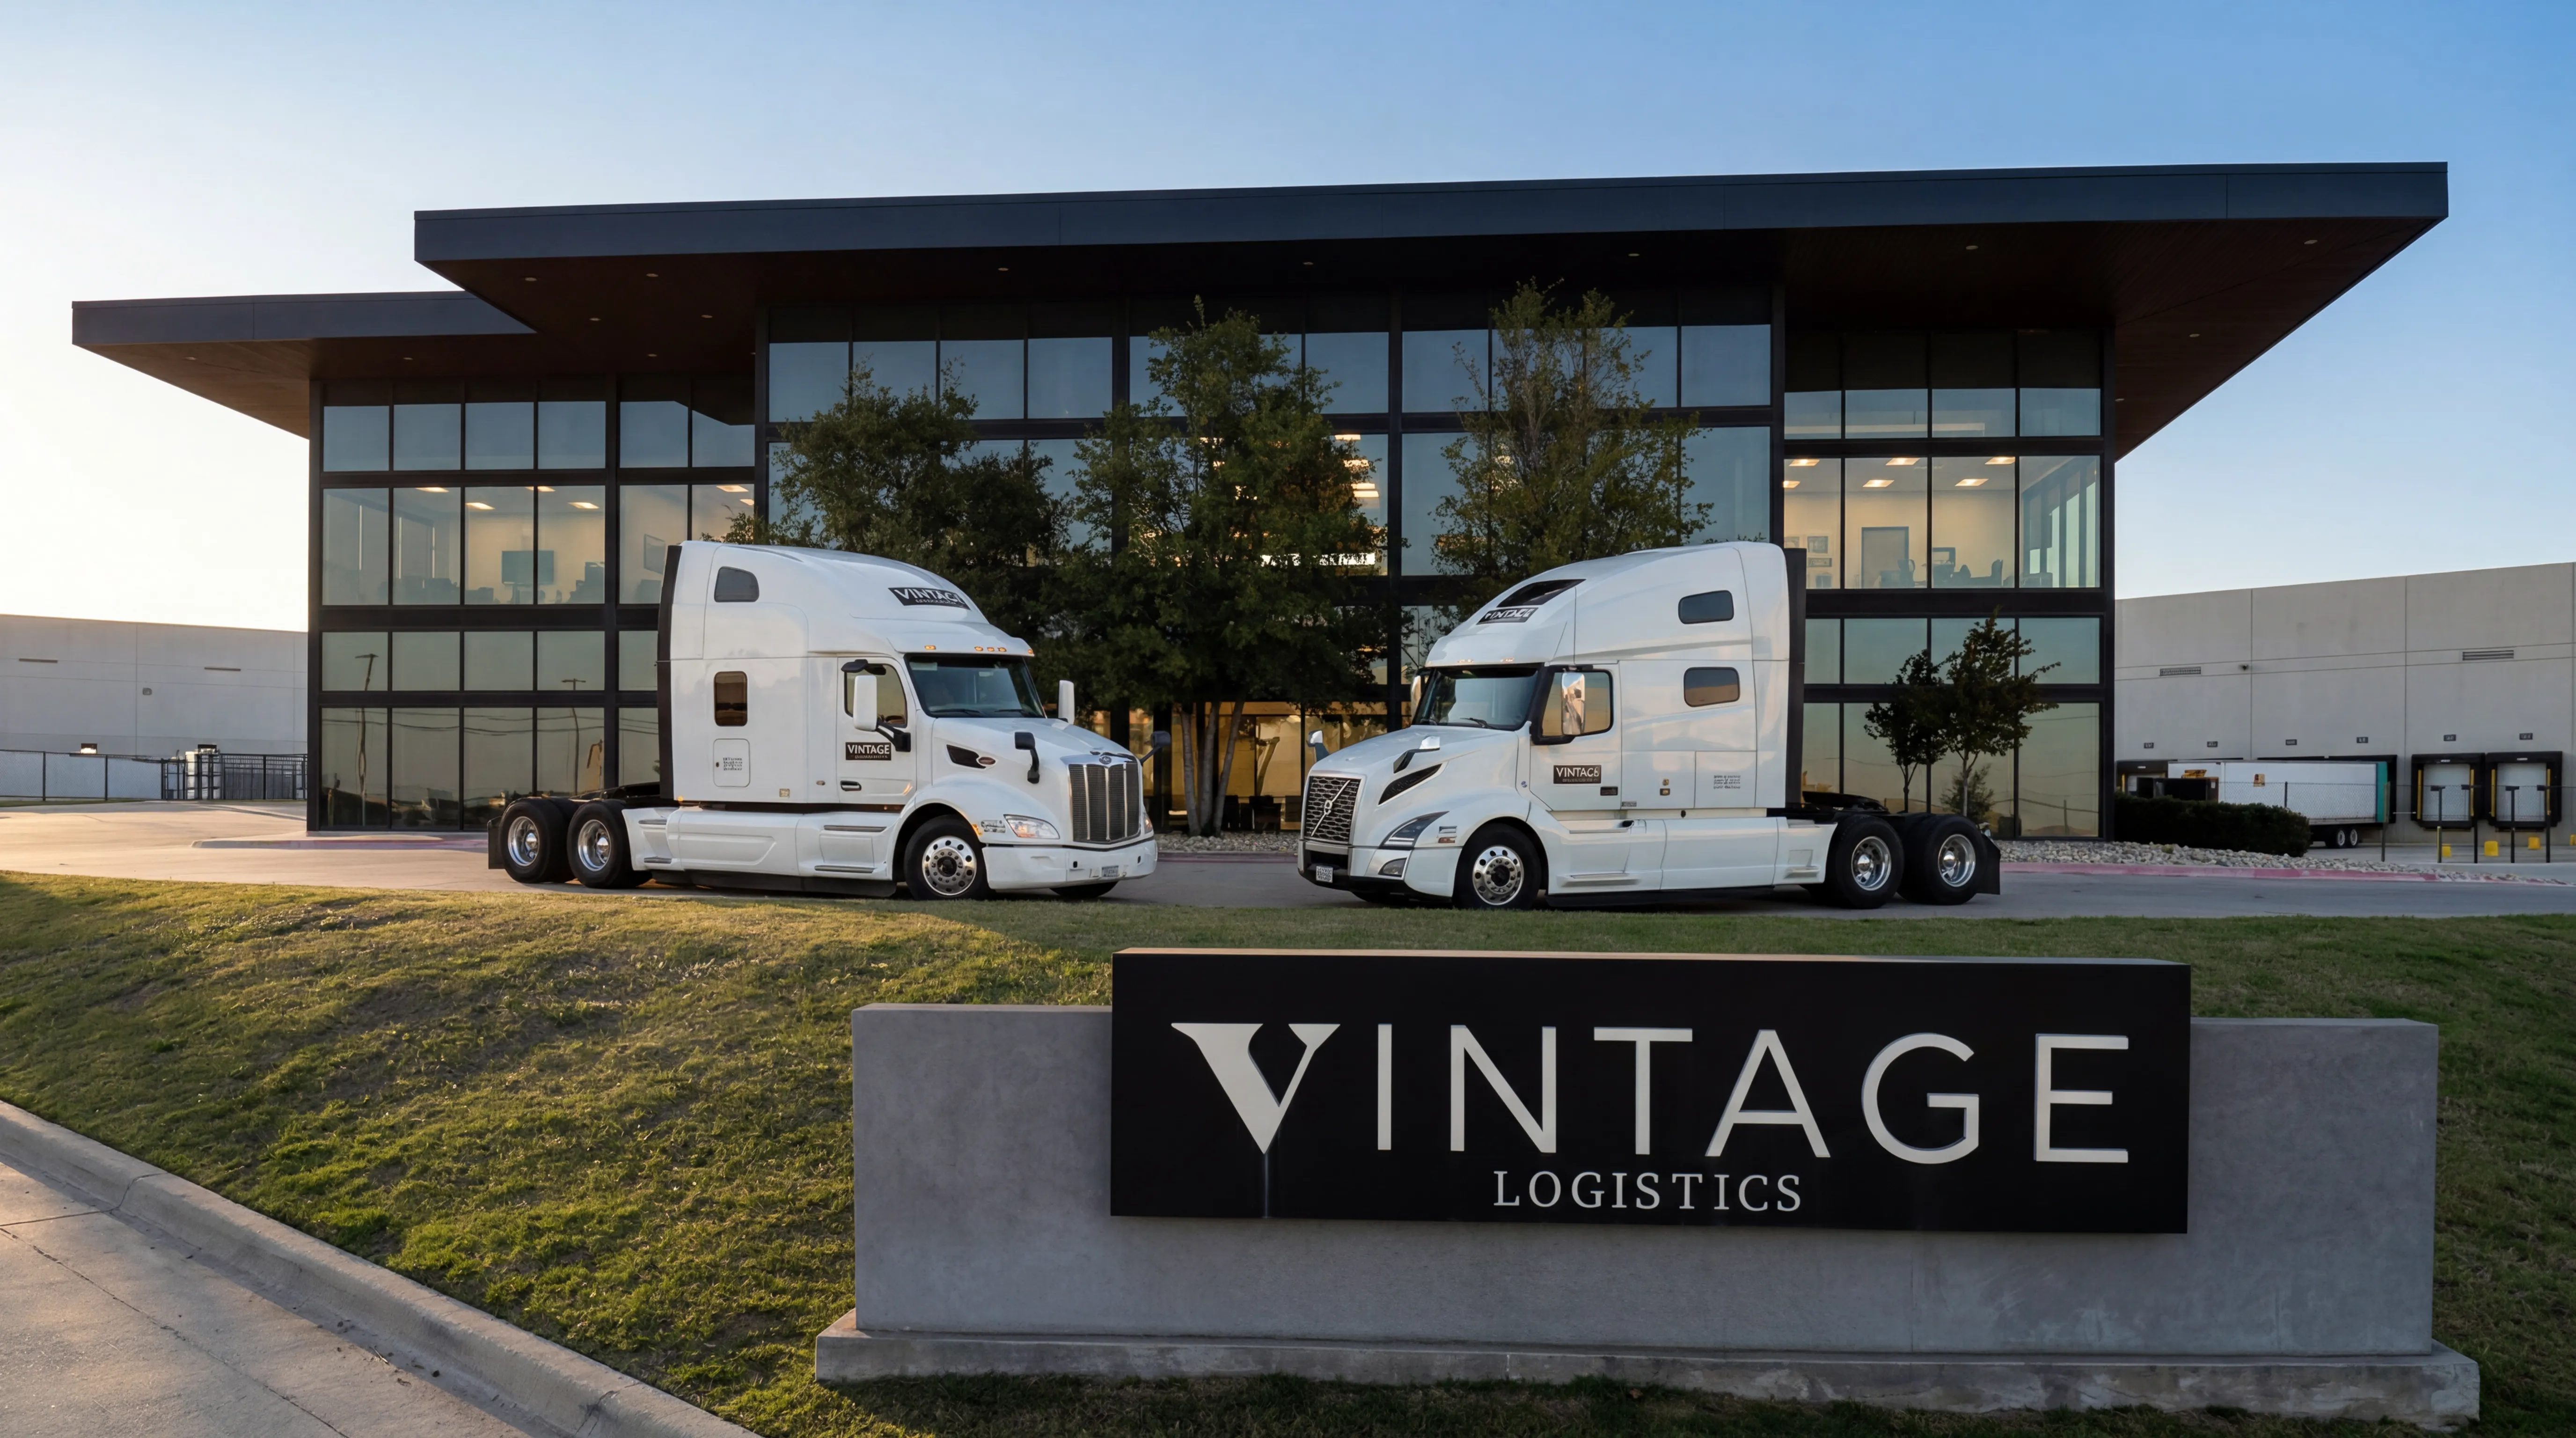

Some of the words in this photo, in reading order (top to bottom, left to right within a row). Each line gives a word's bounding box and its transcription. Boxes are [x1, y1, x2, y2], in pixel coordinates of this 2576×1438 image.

[847, 744, 890, 754] VINTAGE
[1171, 1023, 2129, 1164] VINTAGE
[1493, 1171, 1801, 1211] LOGISTICS
